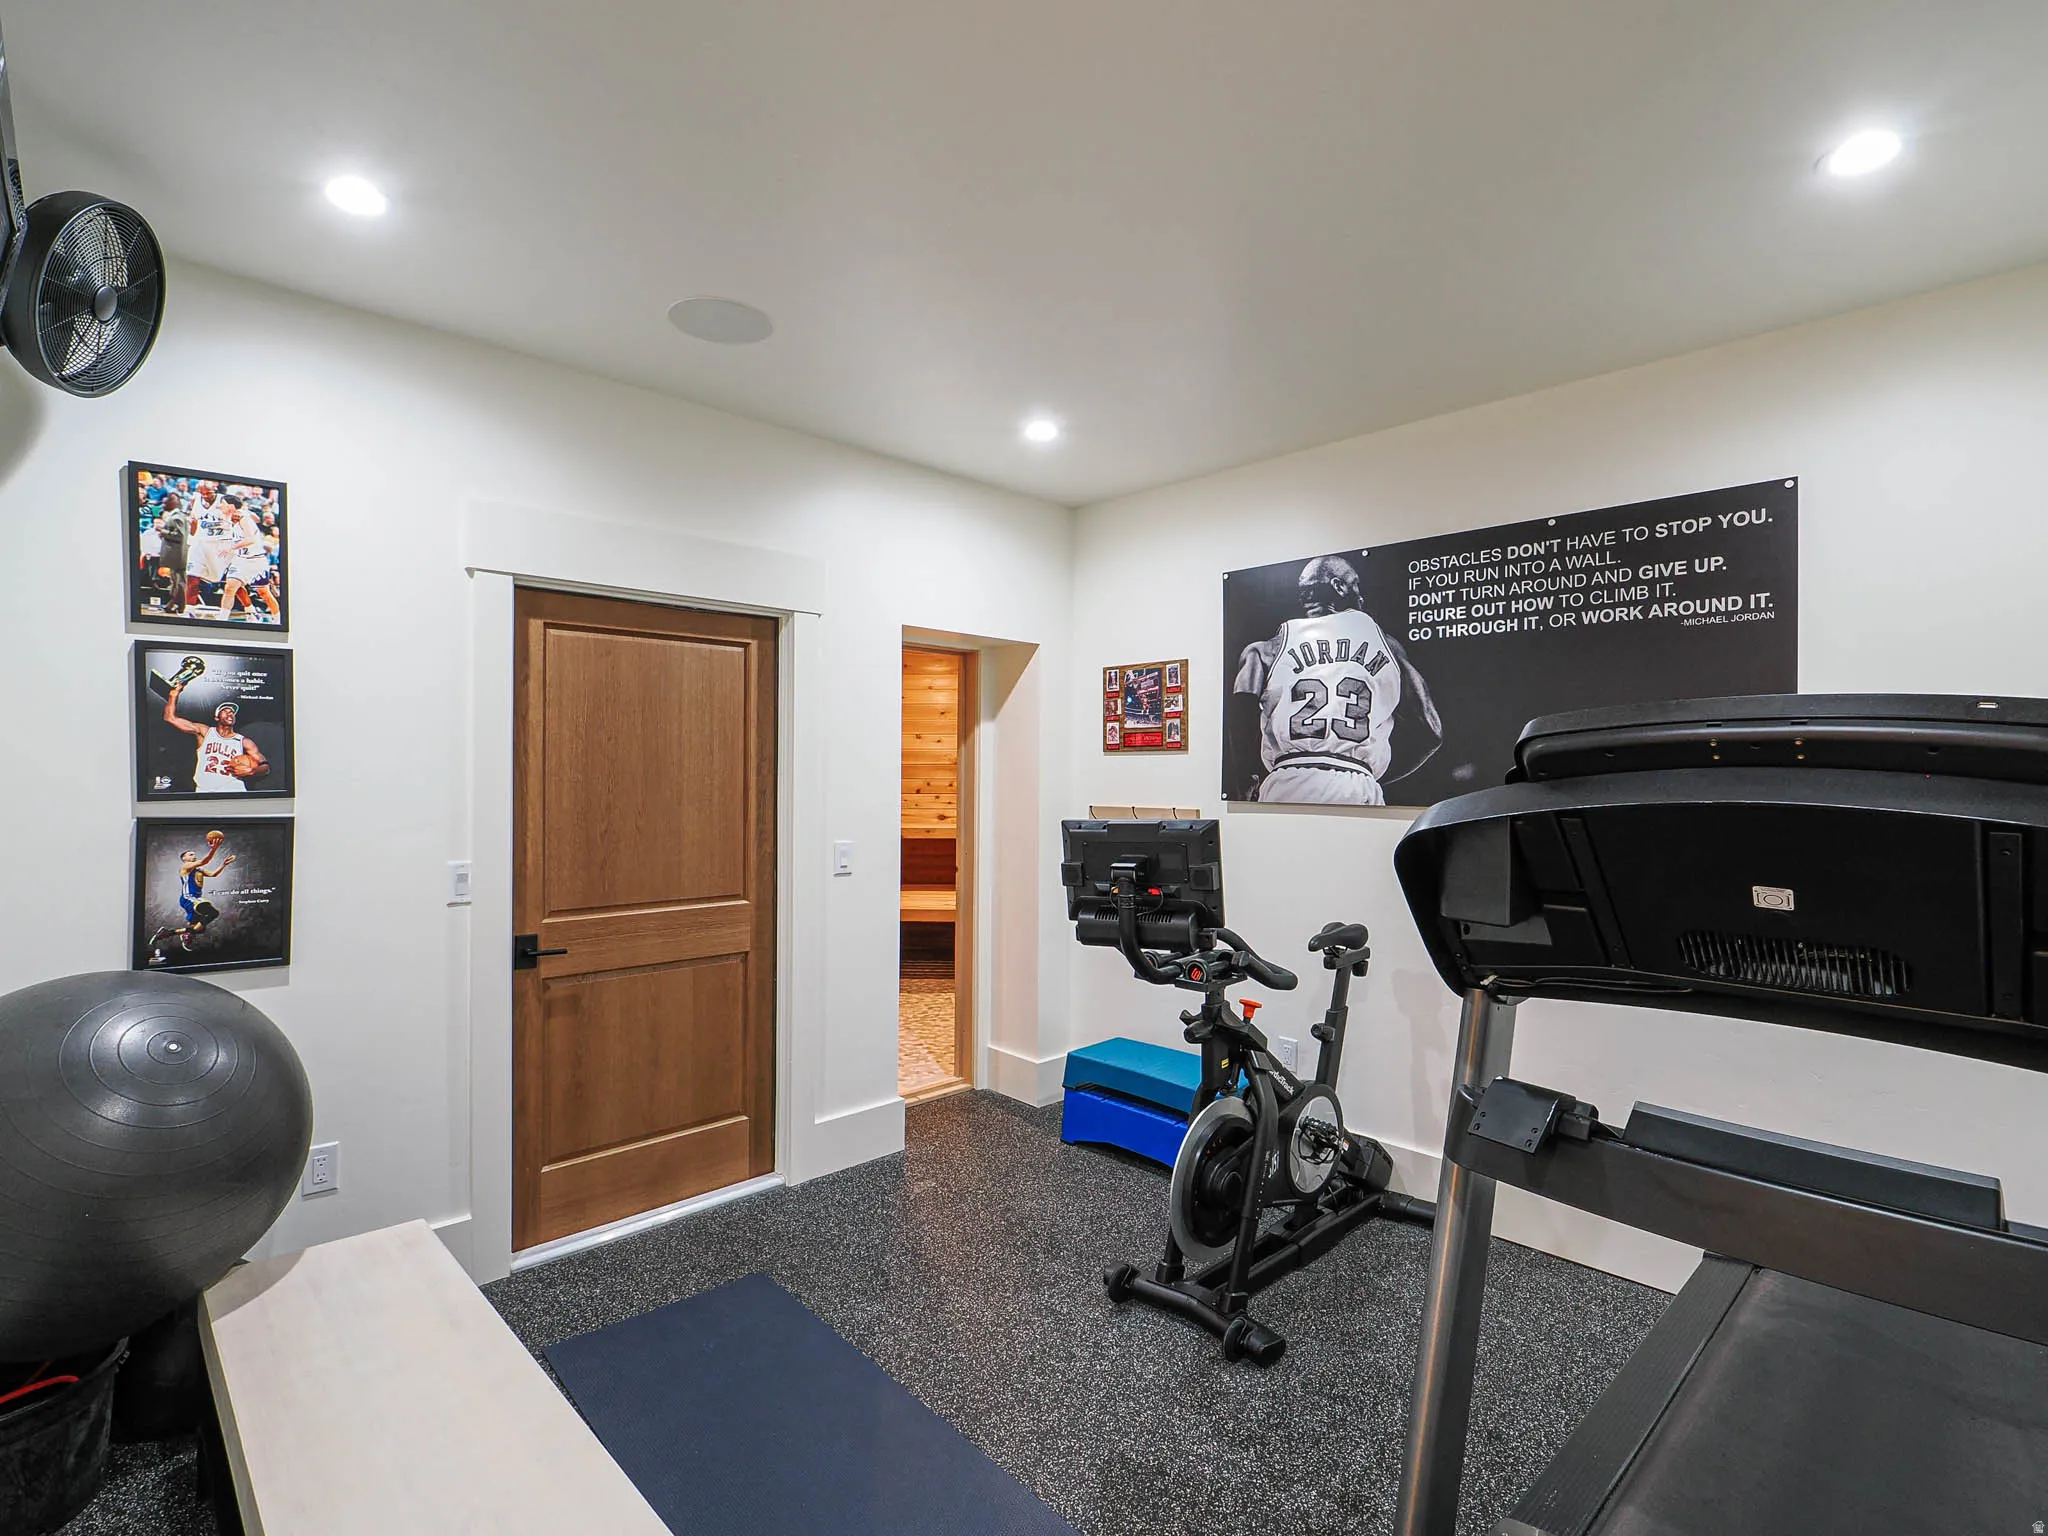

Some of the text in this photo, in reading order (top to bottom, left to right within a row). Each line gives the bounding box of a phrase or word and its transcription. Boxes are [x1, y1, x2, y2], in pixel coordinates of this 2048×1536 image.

[1408, 508, 1773, 573] OBSTACLES DON'T HAVE TO STOP YOU.
[1408, 551, 1621, 591] IF YOU RUN INTO A WALL.
[1408, 556, 1727, 608] DON'T TURN AROUND AND GIVE UP.
[1408, 582, 1676, 625] FIGURE OUT HOW TO CLIMB IT.
[1408, 592, 1773, 641] GO THROUGH IT, OR WORK AROUND IT.
[1680, 611, 1775, 627] -MICHAEL JORDAN
[1287, 639, 1390, 677] JORDAN
[1289, 677, 1372, 743] 23
